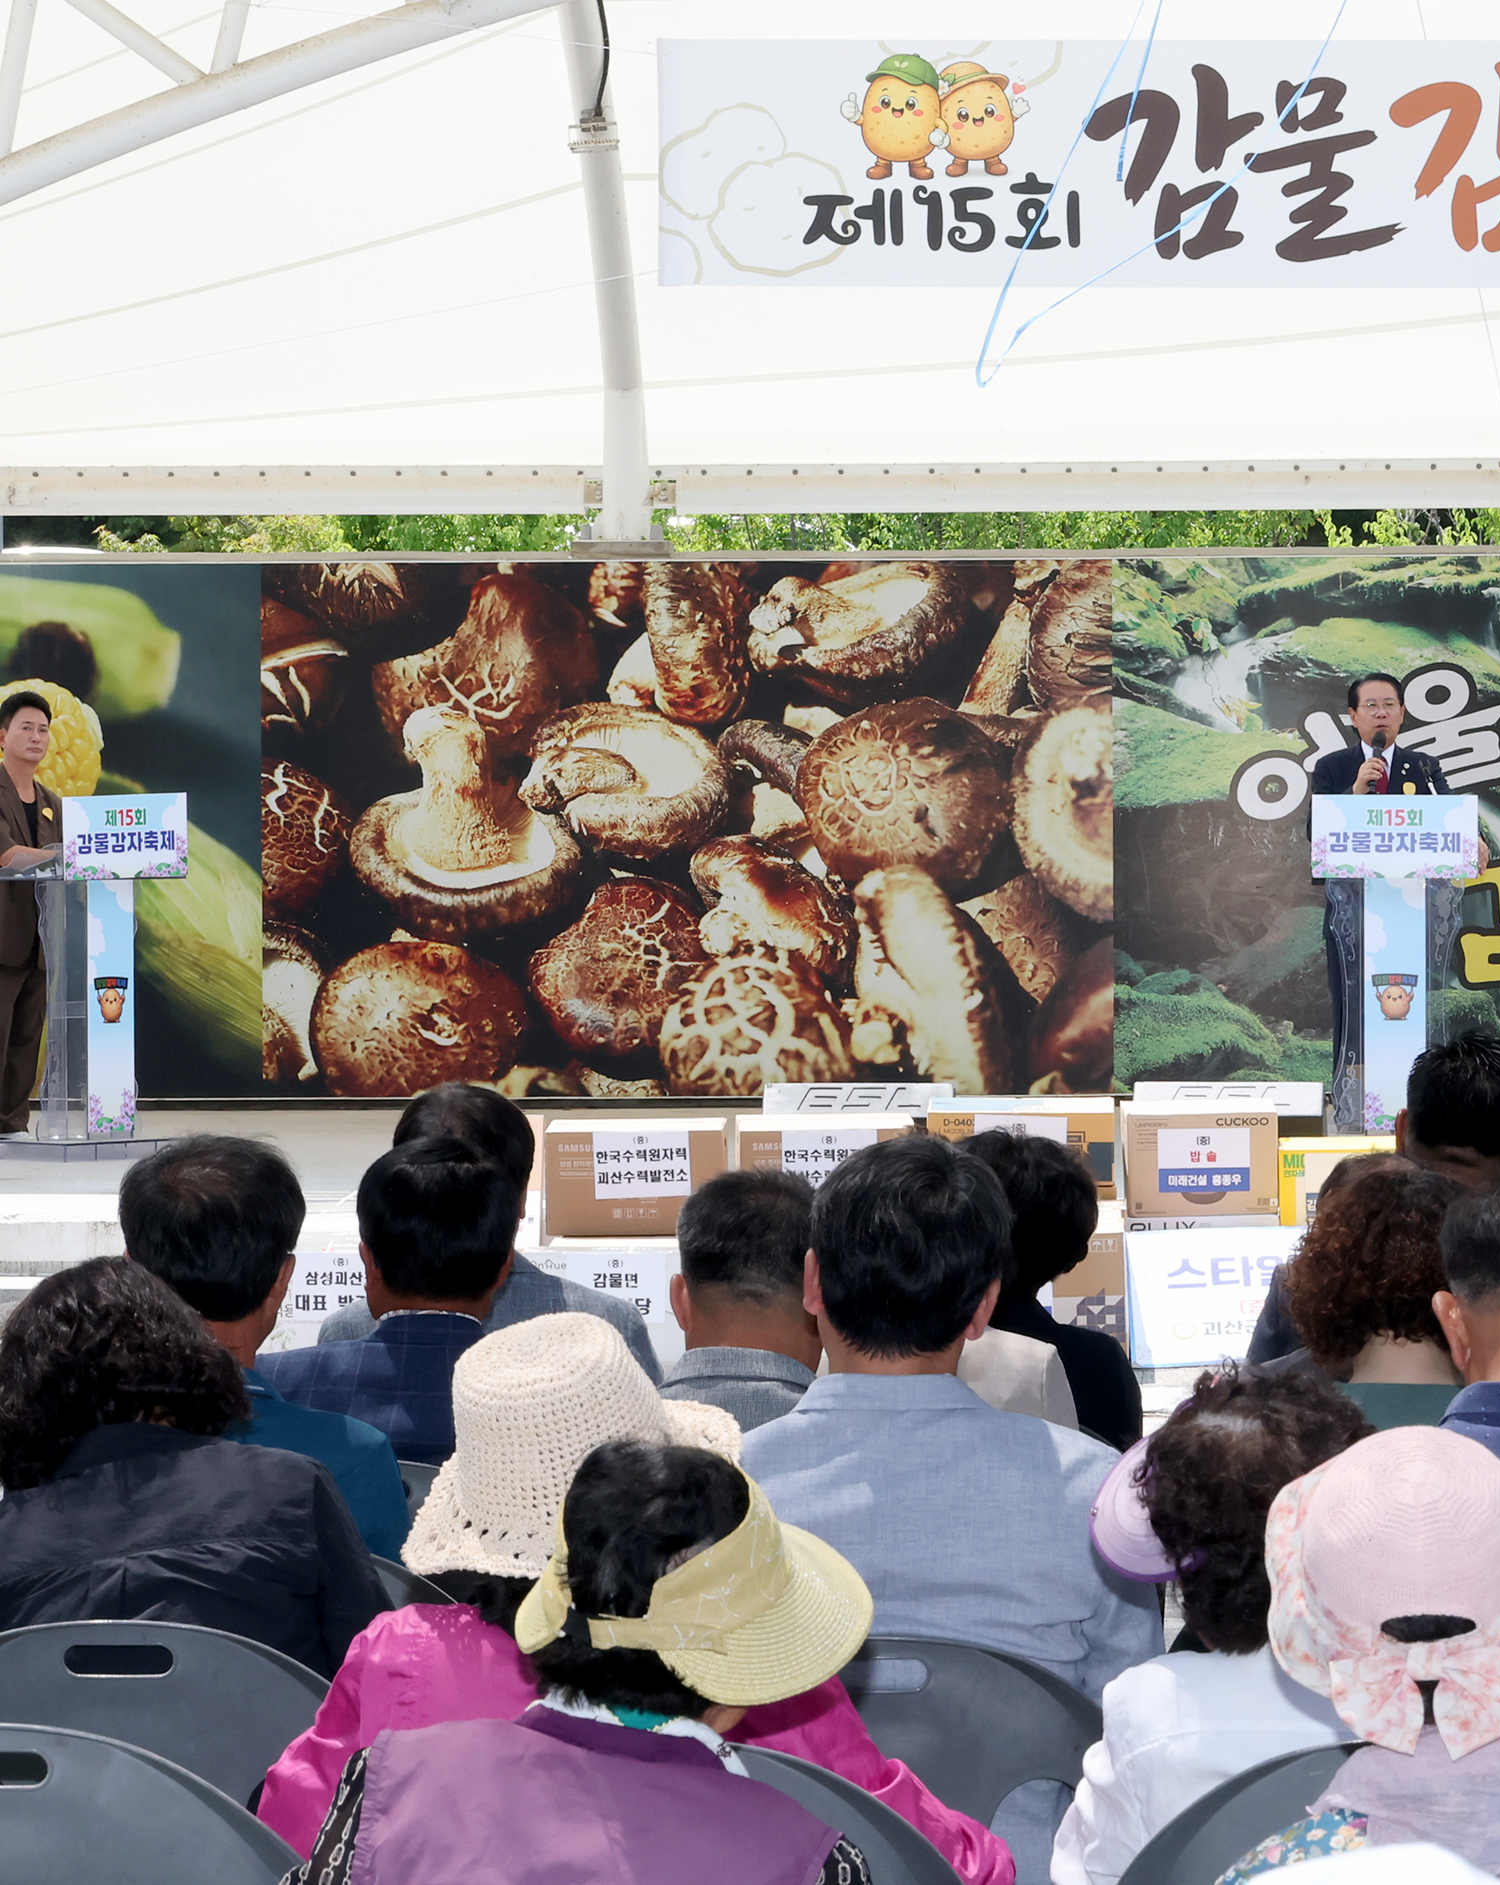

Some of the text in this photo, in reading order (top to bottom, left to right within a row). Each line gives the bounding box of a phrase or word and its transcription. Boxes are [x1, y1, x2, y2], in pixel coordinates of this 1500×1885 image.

[803, 172, 1081, 252] 제15회
[1083, 64, 1407, 263] 감물
[104, 808, 147, 827] 제15회
[1366, 808, 1424, 827] 제15회
[77, 830, 176, 854] 감물감자축제
[1328, 831, 1462, 854] 감물감자축제
[1216, 1117, 1269, 1127] CUCKOO
[558, 1144, 593, 1152] SAMSU
[596, 1148, 687, 1165] 한국수력원자력
[597, 1169, 689, 1185] 괴산수력발전소
[1167, 1174, 1207, 1187] 미래건설
[305, 1271, 366, 1287] 삼성괴산
[593, 1273, 638, 1288] 감물면
[295, 1295, 328, 1311] 대표
